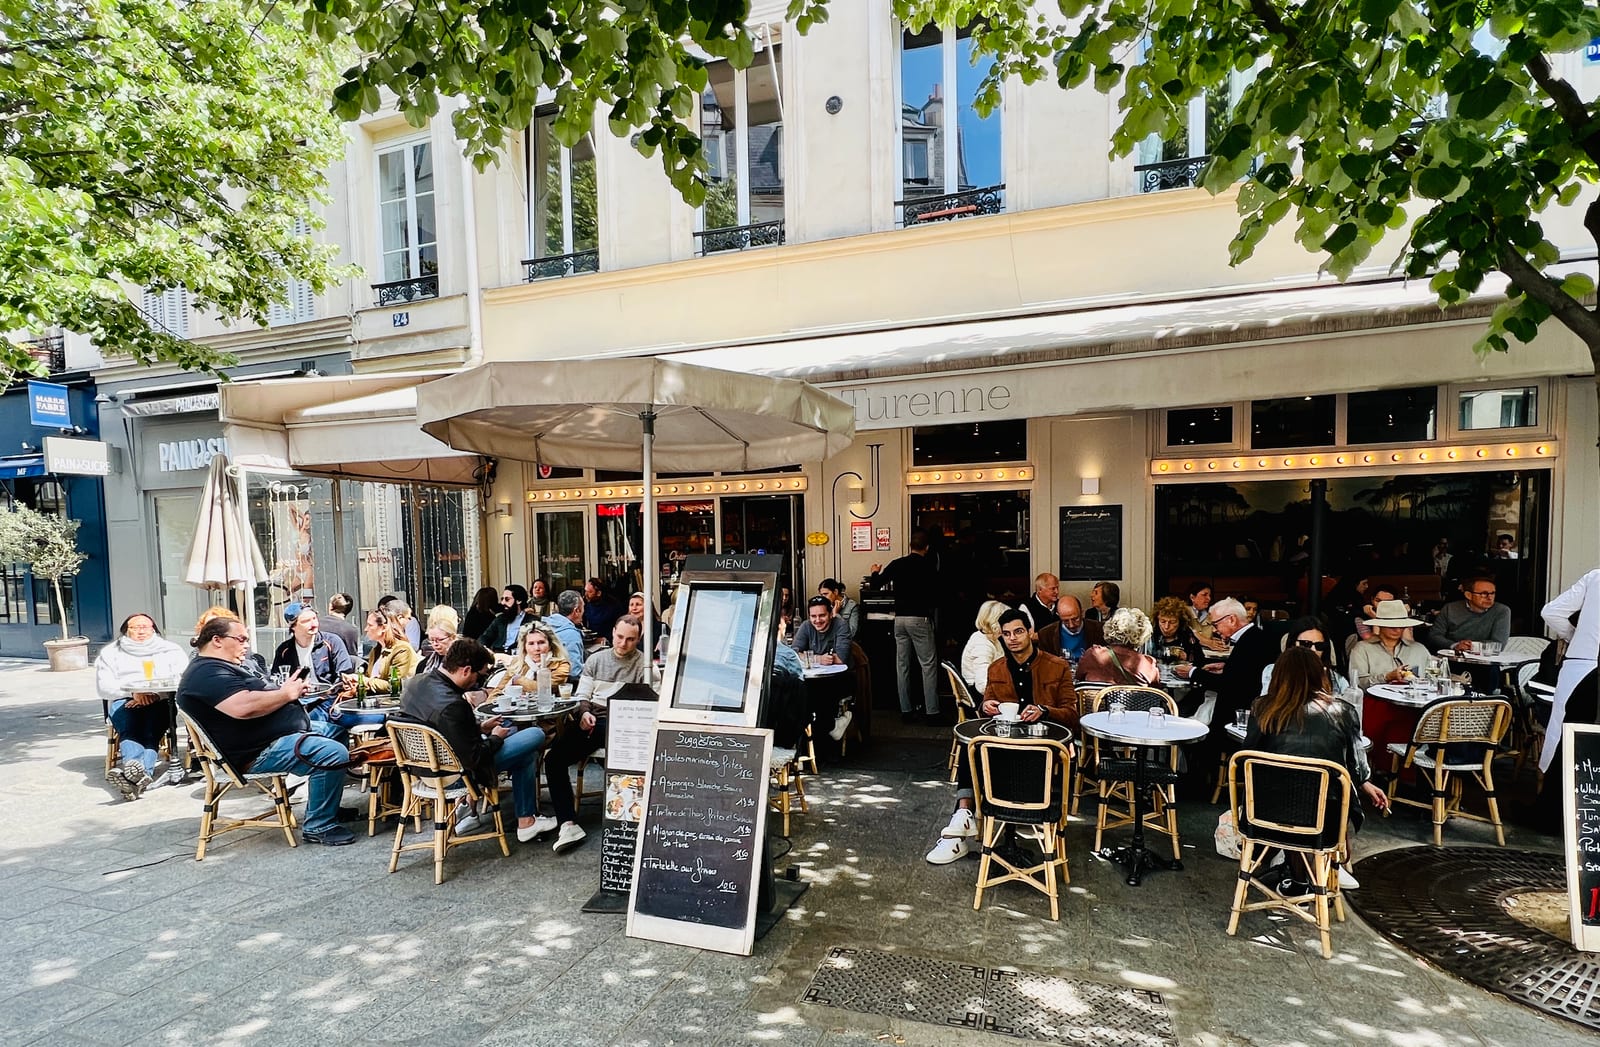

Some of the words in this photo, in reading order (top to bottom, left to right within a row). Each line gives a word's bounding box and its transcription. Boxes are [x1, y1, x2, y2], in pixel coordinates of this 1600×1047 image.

[394, 313, 407, 326] 24
[35, 394, 65, 405] MARIUS
[841, 385, 1011, 421] Turenne
[37, 402, 66, 412] FABRE
[715, 558, 750, 570] MENU
[675, 732, 723, 748] Suggestions
[660, 749, 685, 772] Moules
[1577, 808, 1600, 822] Tun
